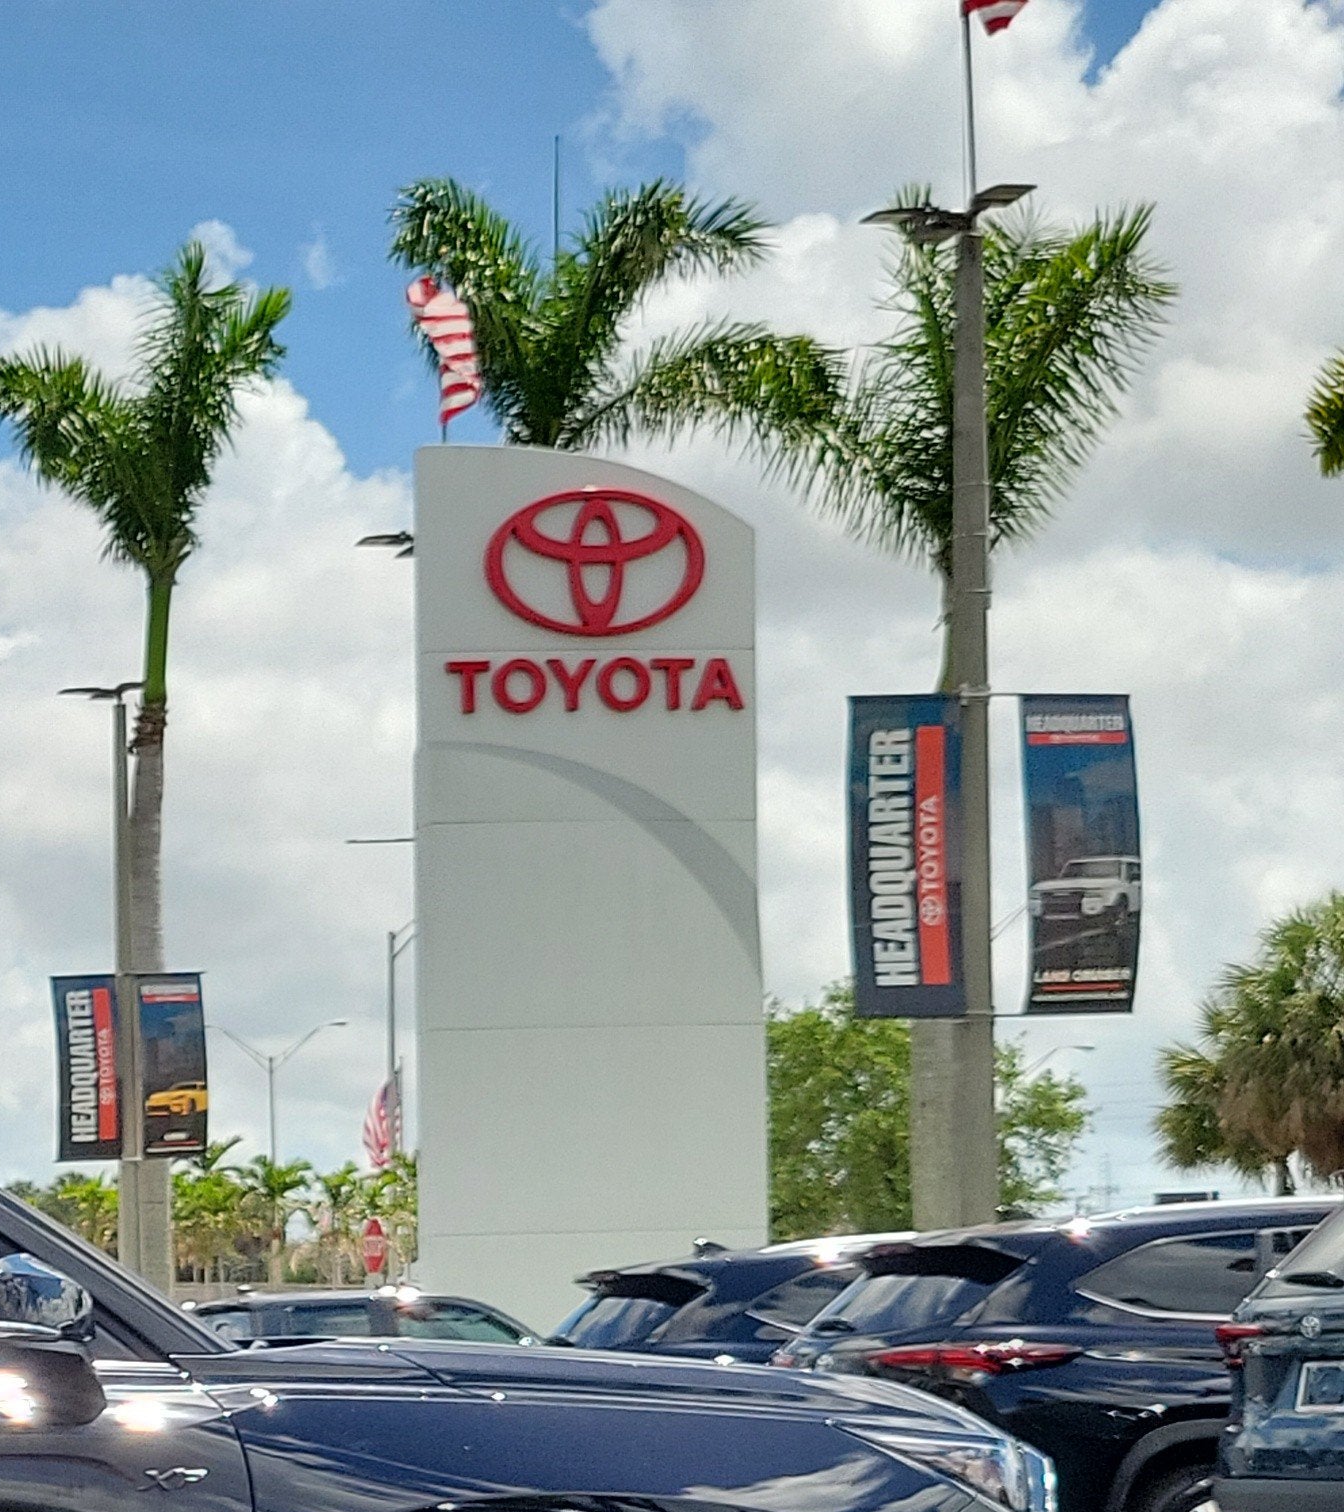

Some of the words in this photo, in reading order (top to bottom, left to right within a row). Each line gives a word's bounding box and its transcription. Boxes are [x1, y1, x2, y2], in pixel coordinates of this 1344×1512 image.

[445, 657, 745, 714] TOYOTA
[869, 727, 920, 987] HEADQUARTER
[919, 795, 941, 897] TOYOTA
[66, 990, 99, 1142] HEADQUARTER
[98, 1028, 114, 1086] TOYOTA
